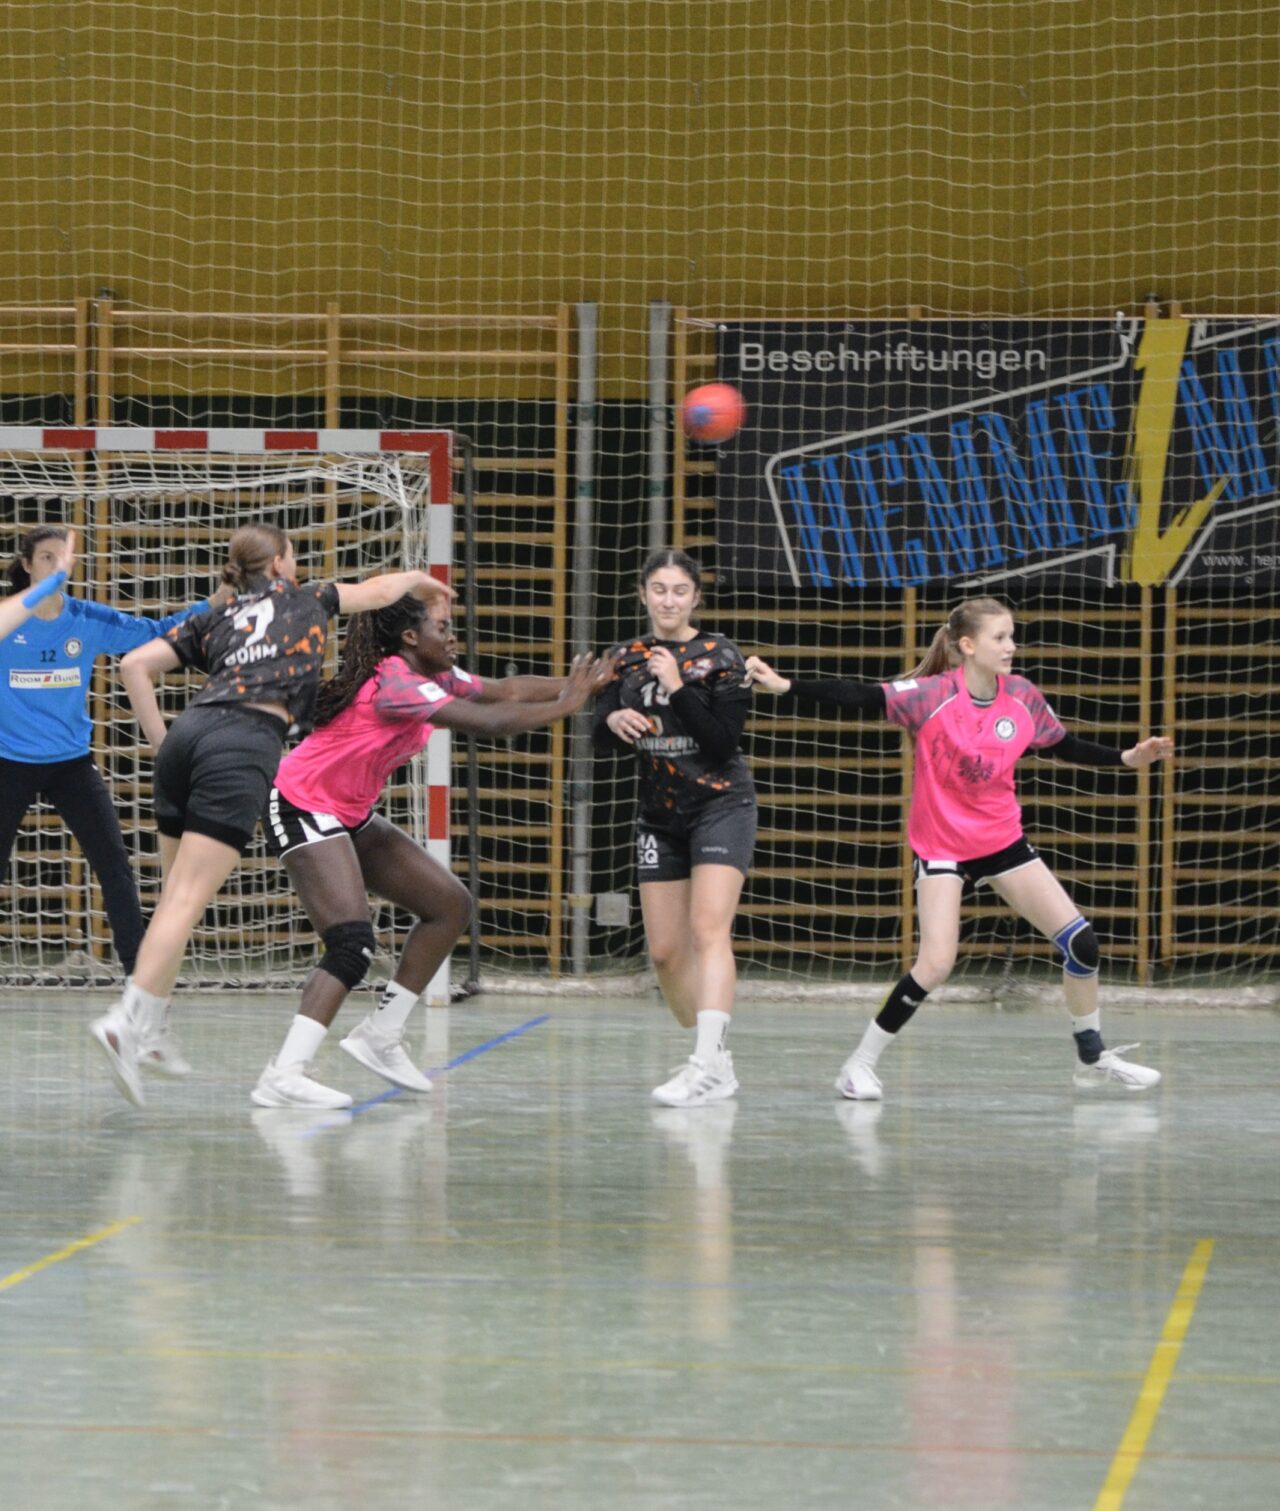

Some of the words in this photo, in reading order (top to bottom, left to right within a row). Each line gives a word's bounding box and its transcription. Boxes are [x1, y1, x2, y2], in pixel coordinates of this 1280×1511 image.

[738, 342, 1047, 379] Beschriftungen
[233, 597, 275, 649] 7
[39, 649, 57, 663] 12
